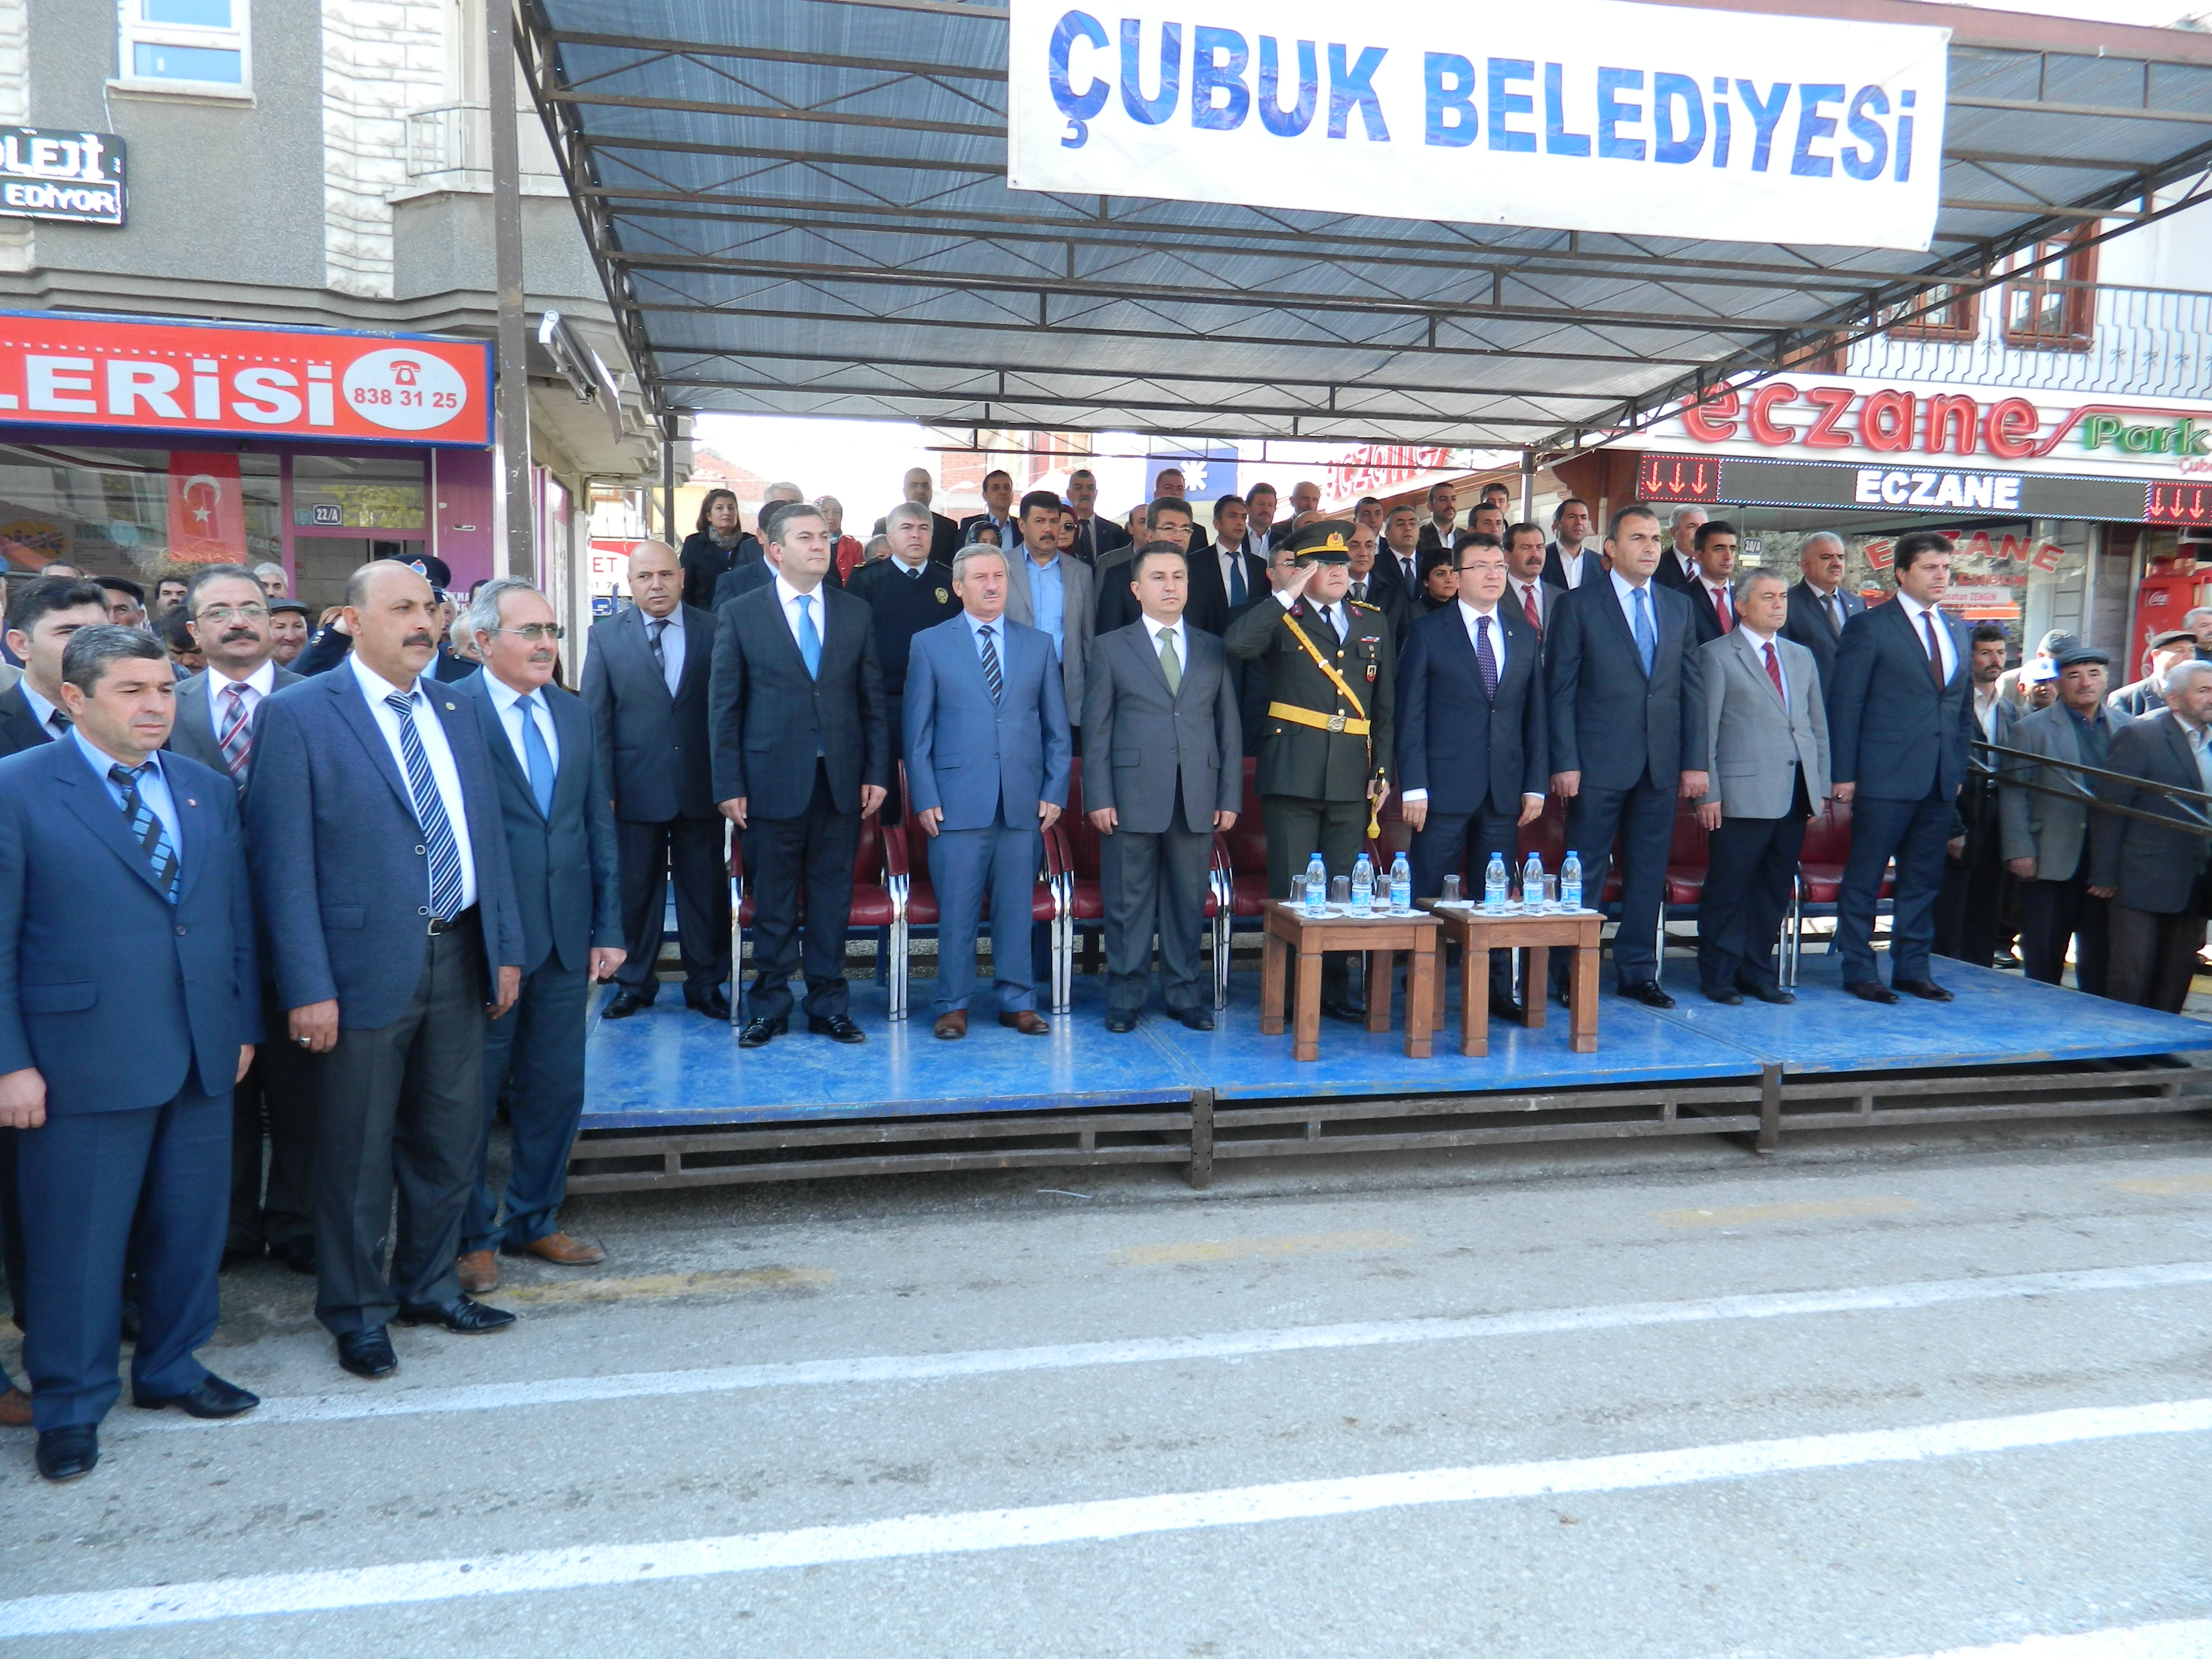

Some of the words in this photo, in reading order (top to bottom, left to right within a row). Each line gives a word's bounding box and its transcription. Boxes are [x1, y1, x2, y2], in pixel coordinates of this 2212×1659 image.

[1049, 10, 1390, 148] ÇUBUK
[1424, 52, 1916, 182] BELEDİYESİ
[0, 133, 104, 179] LEJİ
[4, 183, 116, 213] EDİYOR
[0, 354, 334, 426] ERİSİ
[354, 388, 392, 405] 838
[400, 390, 422, 407] 31
[433, 392, 457, 409] 25
[1683, 380, 2038, 459] eczane
[2084, 415, 2209, 456] Park
[1855, 470, 2020, 510] ECZANE
[316, 508, 338, 521] 22/A
[593, 557, 617, 572] ET
[1745, 540, 1760, 552] 20/A
[1864, 530, 2065, 573] EZANE
